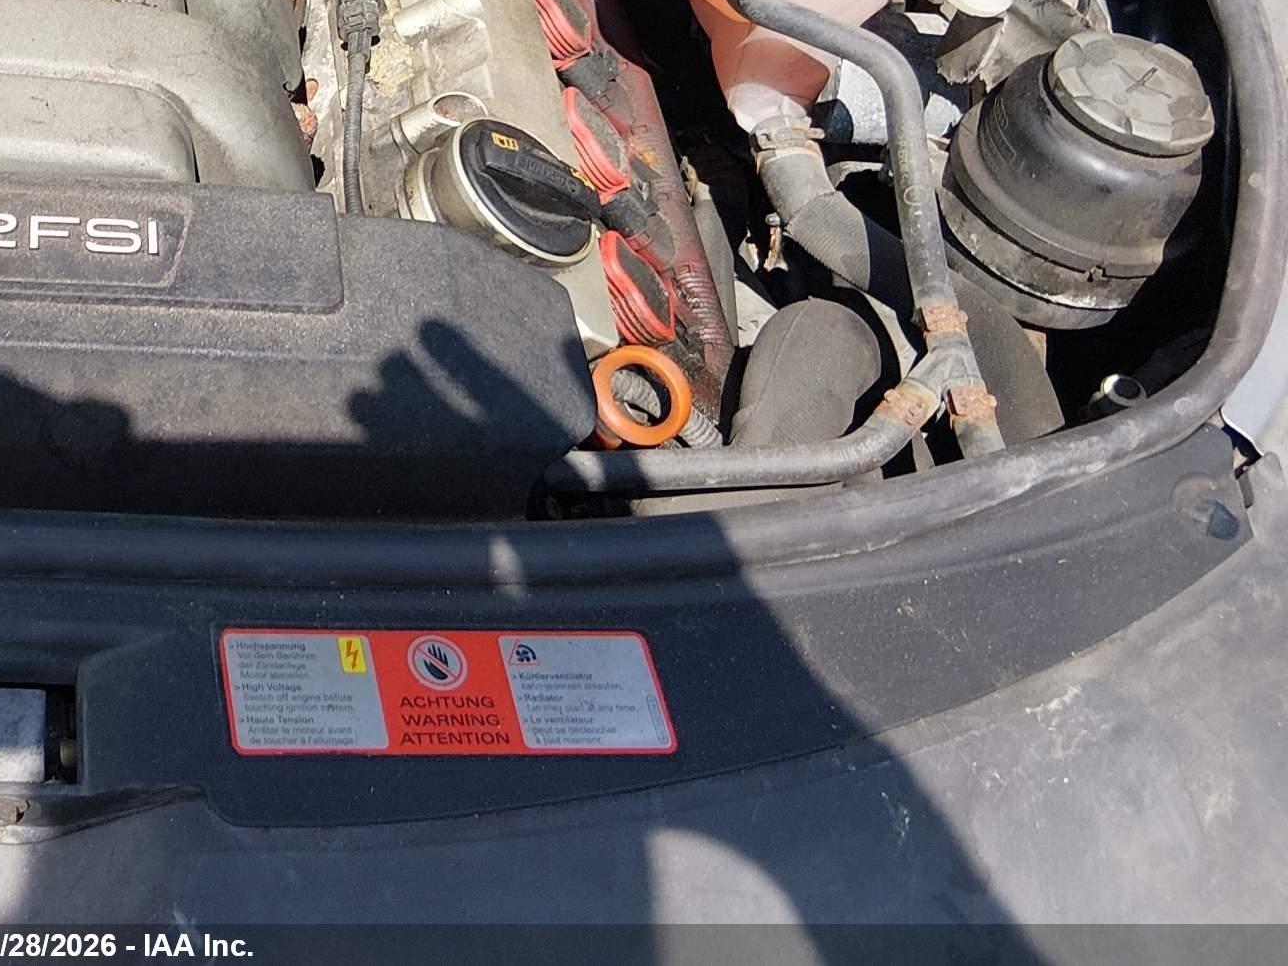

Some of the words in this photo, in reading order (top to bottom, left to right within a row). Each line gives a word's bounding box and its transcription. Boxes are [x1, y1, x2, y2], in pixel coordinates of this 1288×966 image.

[236, 641, 306, 651] Hochspannung
[518, 672, 593, 681] Kühlerventilator
[242, 683, 264, 692] High
[267, 683, 302, 692] Voltage
[243, 694, 273, 702] Switch
[276, 694, 289, 702] off
[292, 695, 322, 703] engine
[323, 694, 353, 702] before
[399, 695, 495, 709] ACHTUNG
[524, 694, 564, 702] Radiator
[245, 703, 283, 713] touching
[286, 703, 318, 713] ignition
[598, 705, 614, 713] any
[247, 715, 275, 724] Haute
[278, 715, 314, 724] Tension
[402, 714, 501, 727] WARNING
[544, 716, 593, 724] ventilateur
[292, 726, 326, 735] moteur
[328, 727, 353, 735] avant
[263, 737, 297, 746] toucher
[400, 732, 510, 746] ATTENTION
[543, 736, 561, 744] tout
